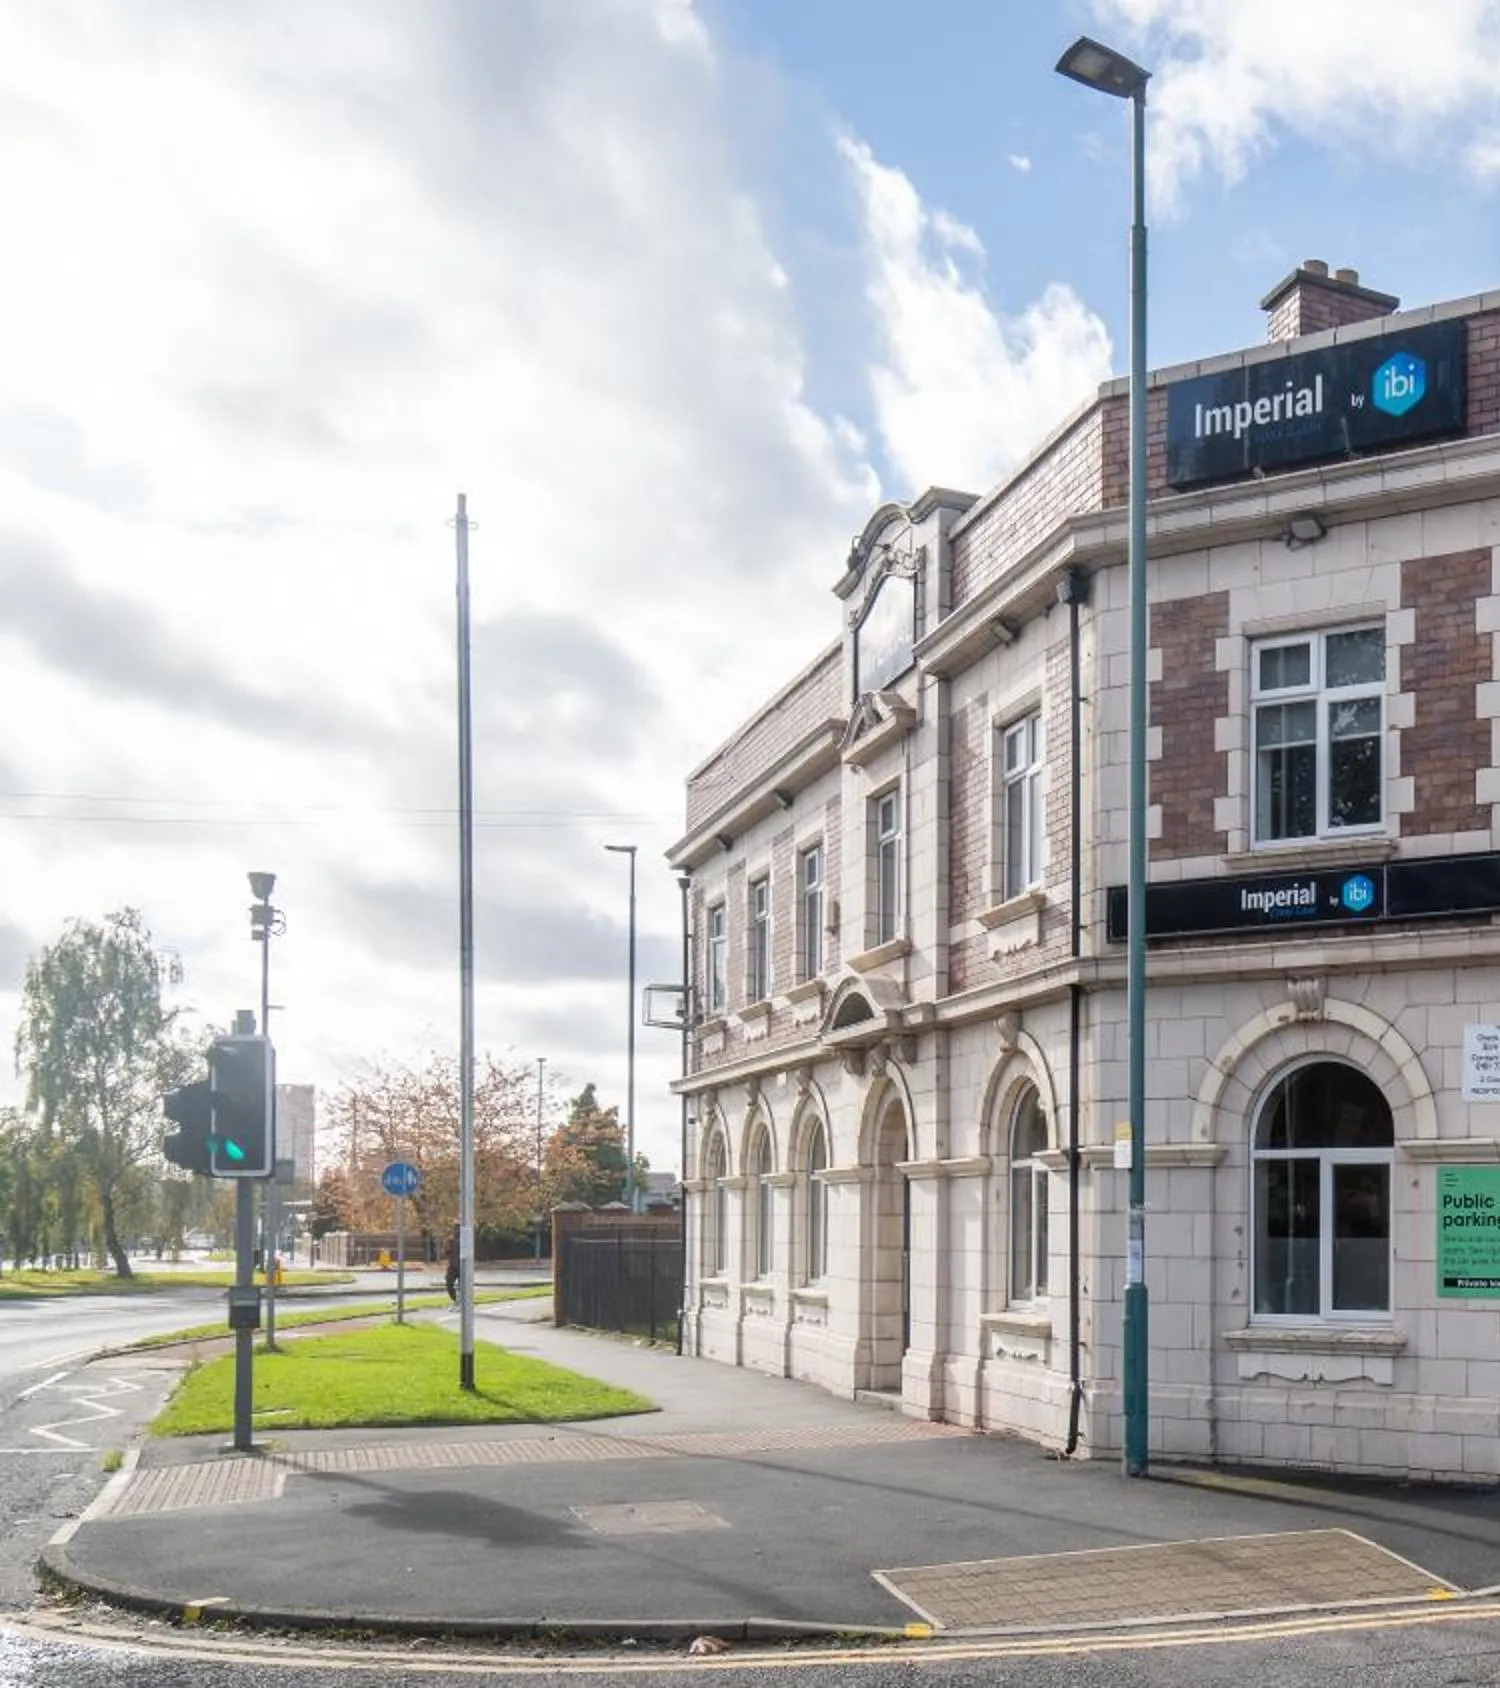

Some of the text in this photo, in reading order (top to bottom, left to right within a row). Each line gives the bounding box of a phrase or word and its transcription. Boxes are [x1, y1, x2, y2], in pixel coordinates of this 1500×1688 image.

[1194, 374, 1323, 439] Imperial
[1351, 394, 1365, 409] by
[1384, 363, 1415, 400] ibi
[1241, 881, 1317, 913] Imperial
[1349, 882, 1367, 900] ibi
[1443, 1194, 1495, 1209] Public
